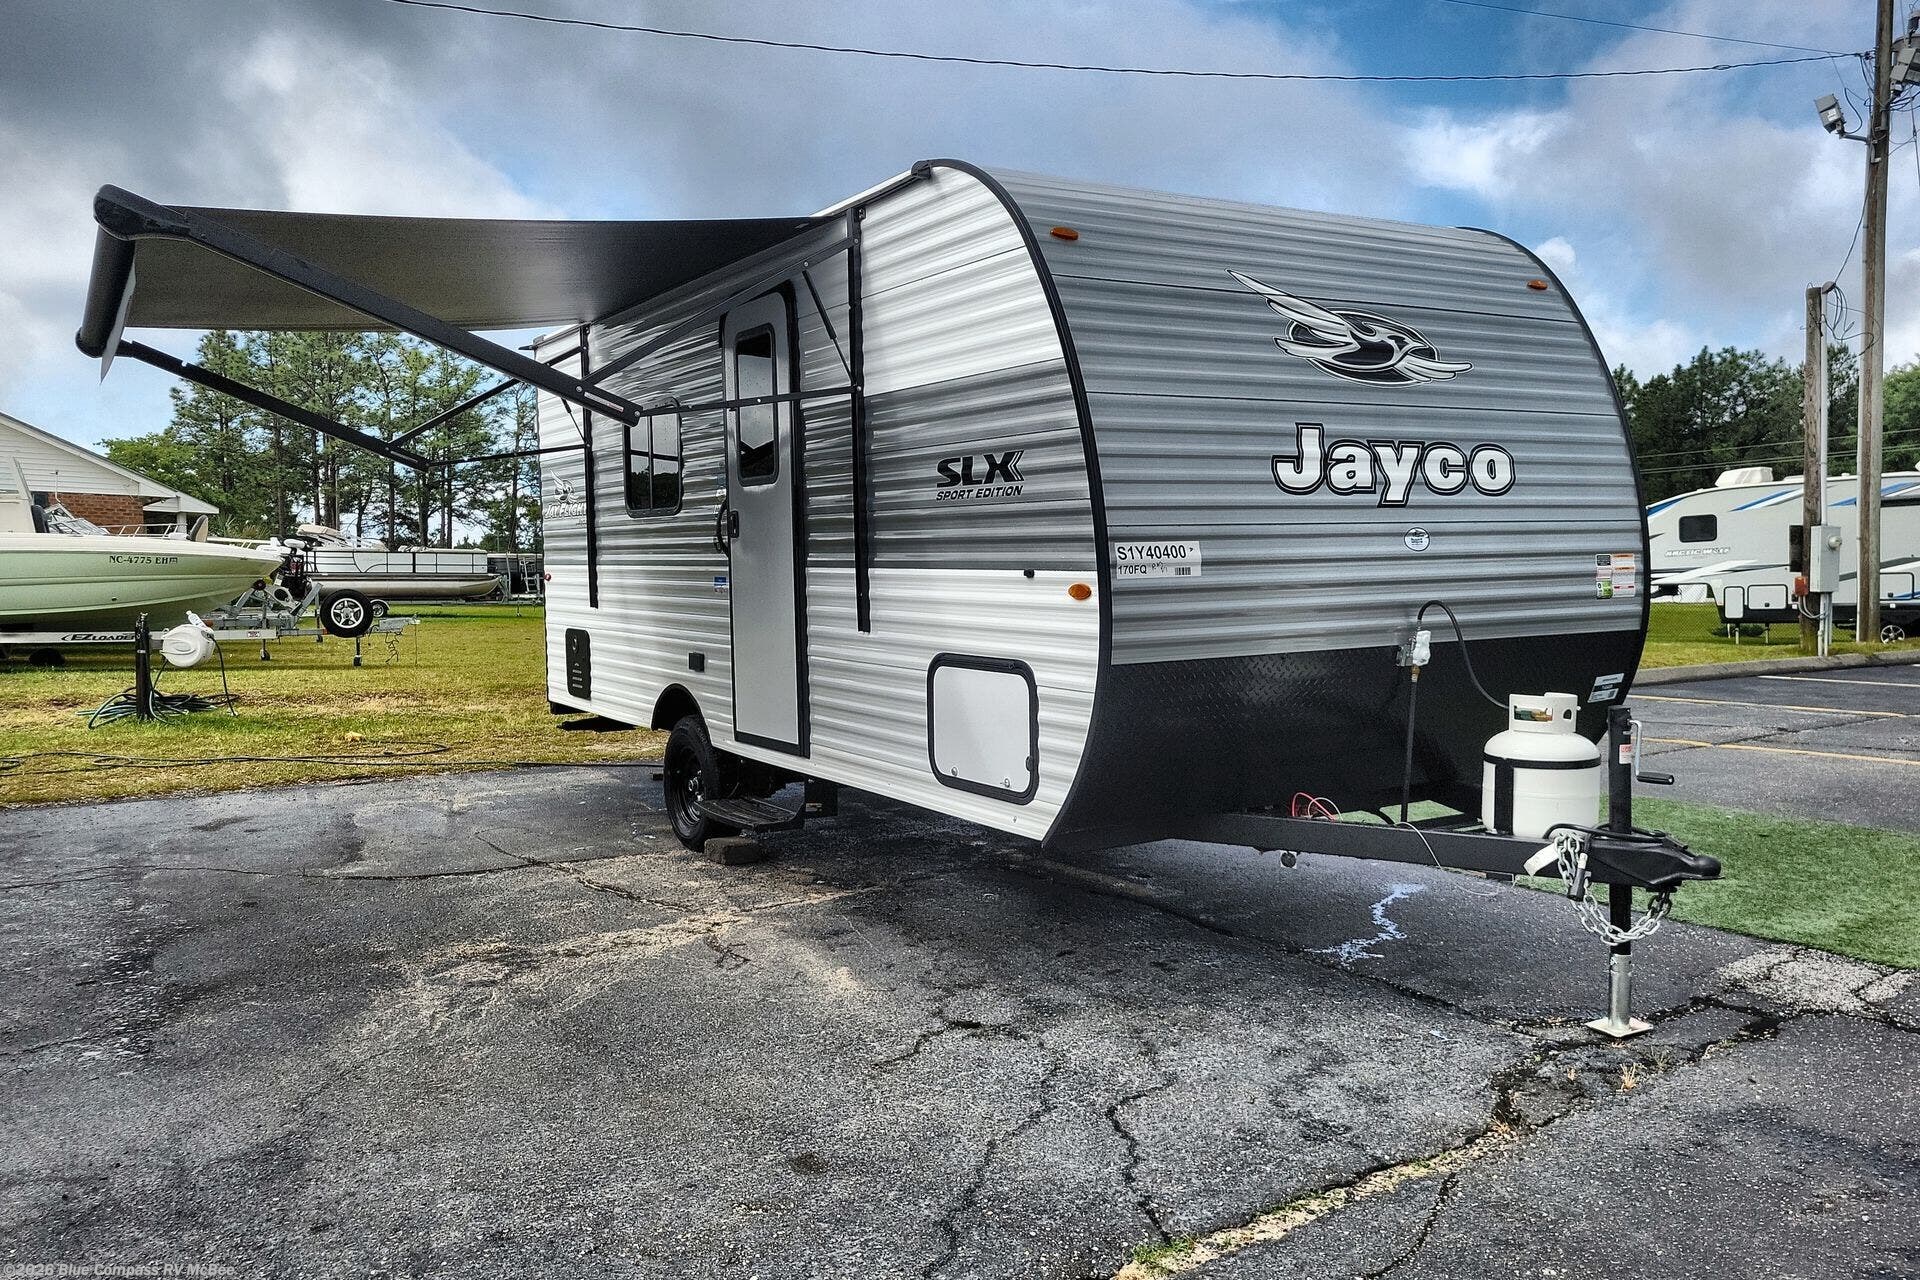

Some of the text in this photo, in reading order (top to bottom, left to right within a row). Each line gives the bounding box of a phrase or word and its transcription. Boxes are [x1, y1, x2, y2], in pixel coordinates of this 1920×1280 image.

[936, 449, 1025, 488] SLX
[1271, 422, 1516, 508] Jayco
[936, 485, 1024, 501] SPORT EDITION
[109, 555, 152, 564] NC-4775
[1117, 544, 1187, 561] S1Y40400
[1118, 564, 1147, 575] 170FQ
